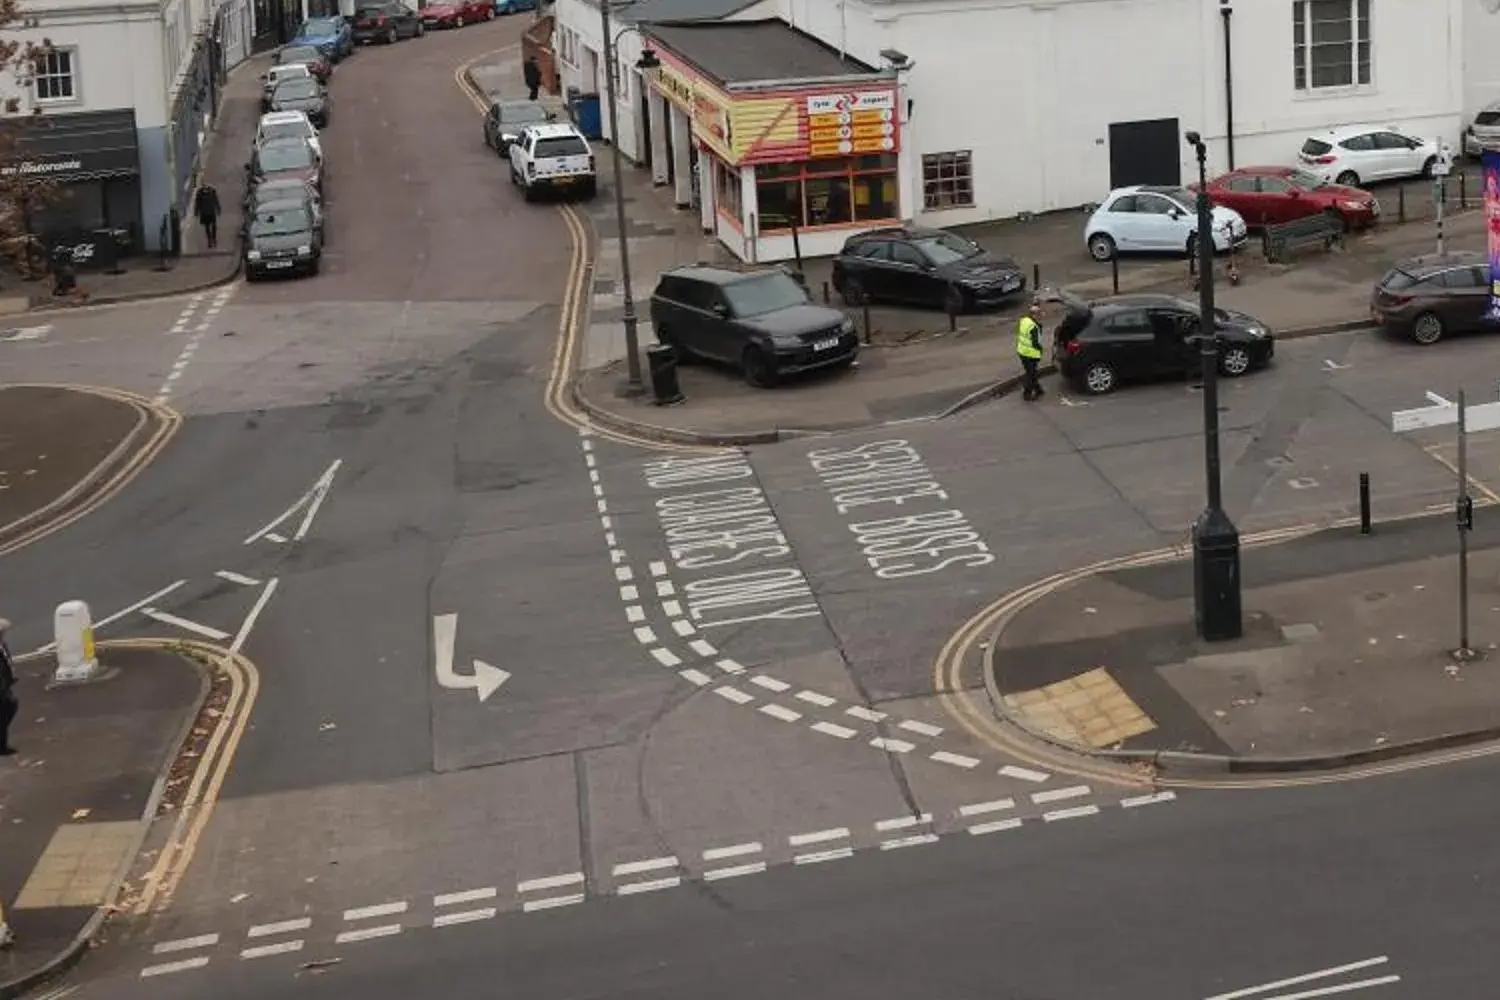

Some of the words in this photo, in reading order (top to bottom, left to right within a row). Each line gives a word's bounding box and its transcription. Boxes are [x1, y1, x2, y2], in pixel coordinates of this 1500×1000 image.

[806, 439, 949, 515] SERVICE
[655, 487, 791, 569] COACHES
[848, 509, 996, 578] BUSES
[684, 568, 821, 629] ONLY
